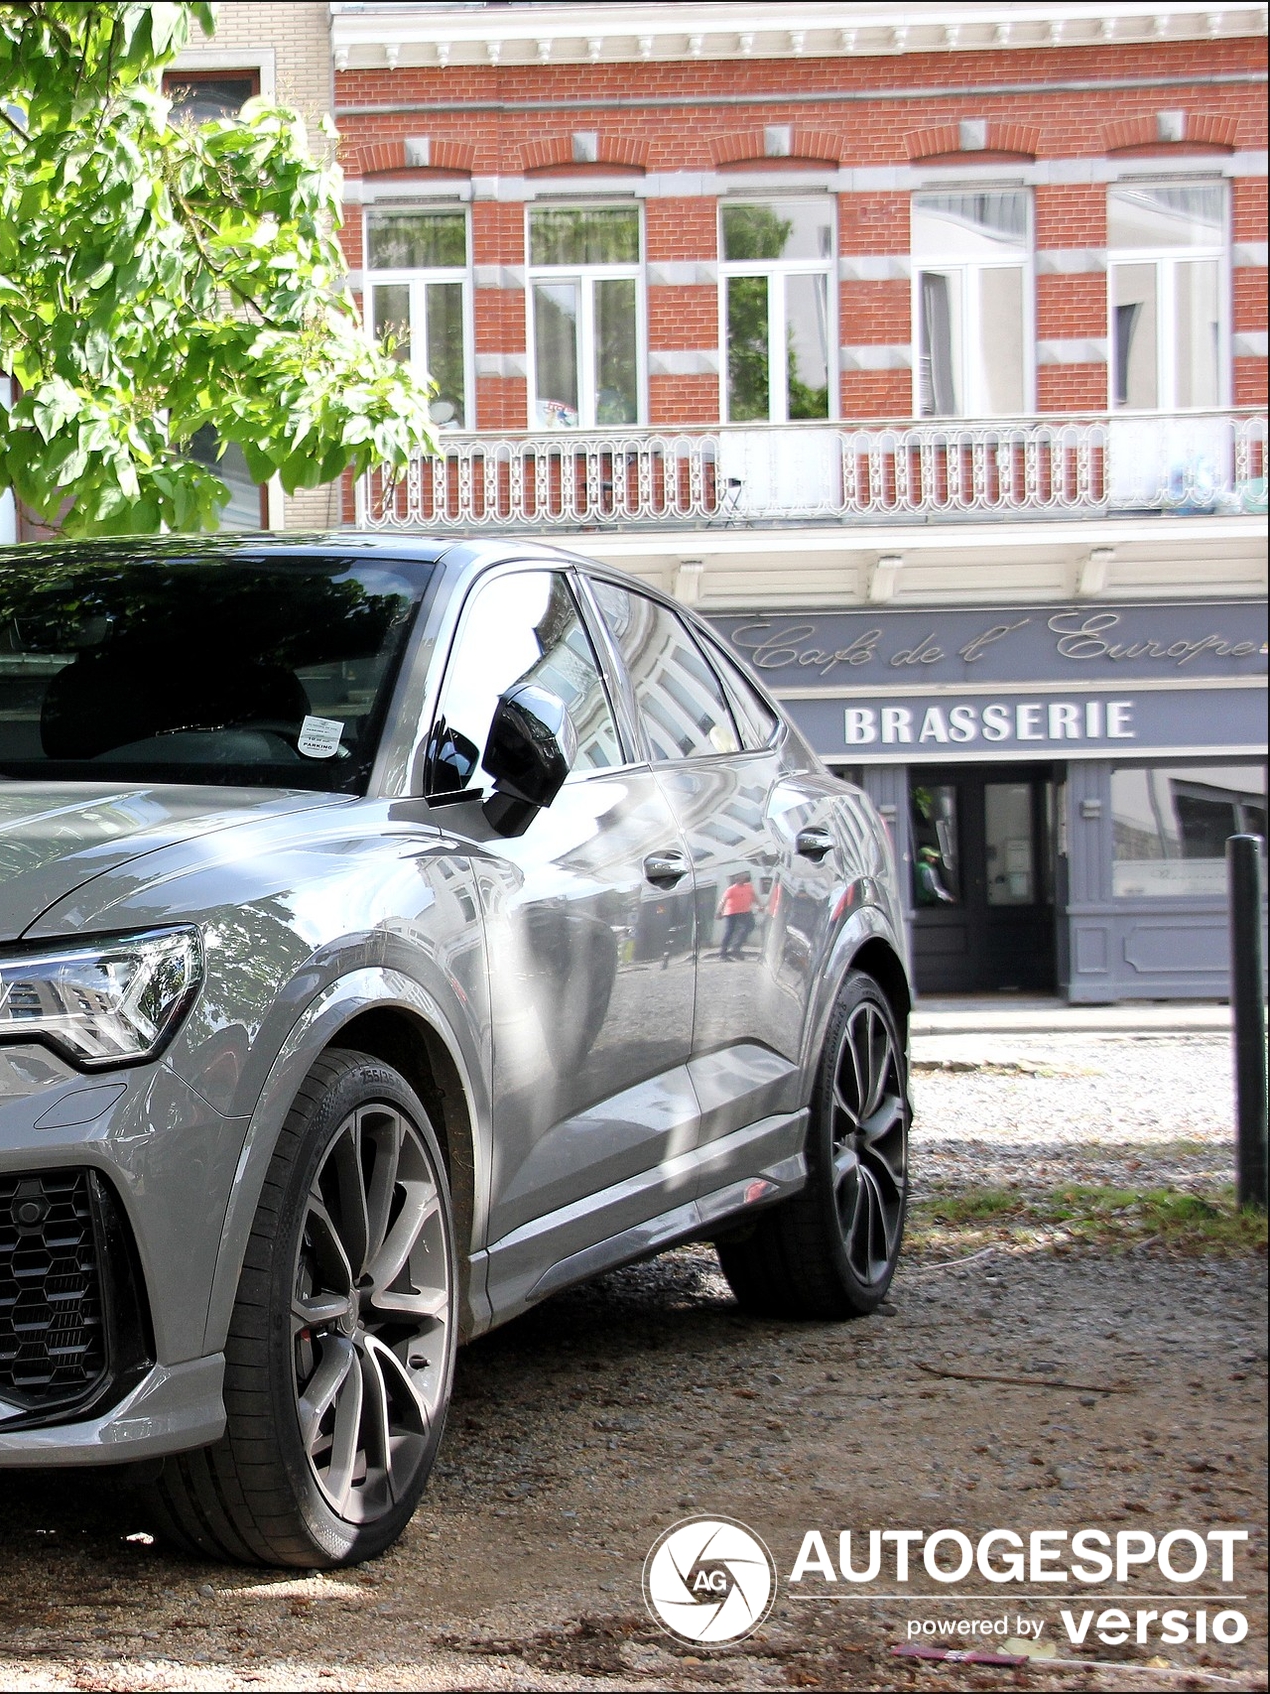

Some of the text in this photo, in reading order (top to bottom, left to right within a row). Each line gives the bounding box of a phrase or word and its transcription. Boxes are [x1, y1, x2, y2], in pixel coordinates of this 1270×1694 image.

[731, 624, 881, 676] Café
[890, 633, 944, 666] de
[1048, 613, 1256, 666] Europe
[844, 700, 1136, 745] BRASSERIE
